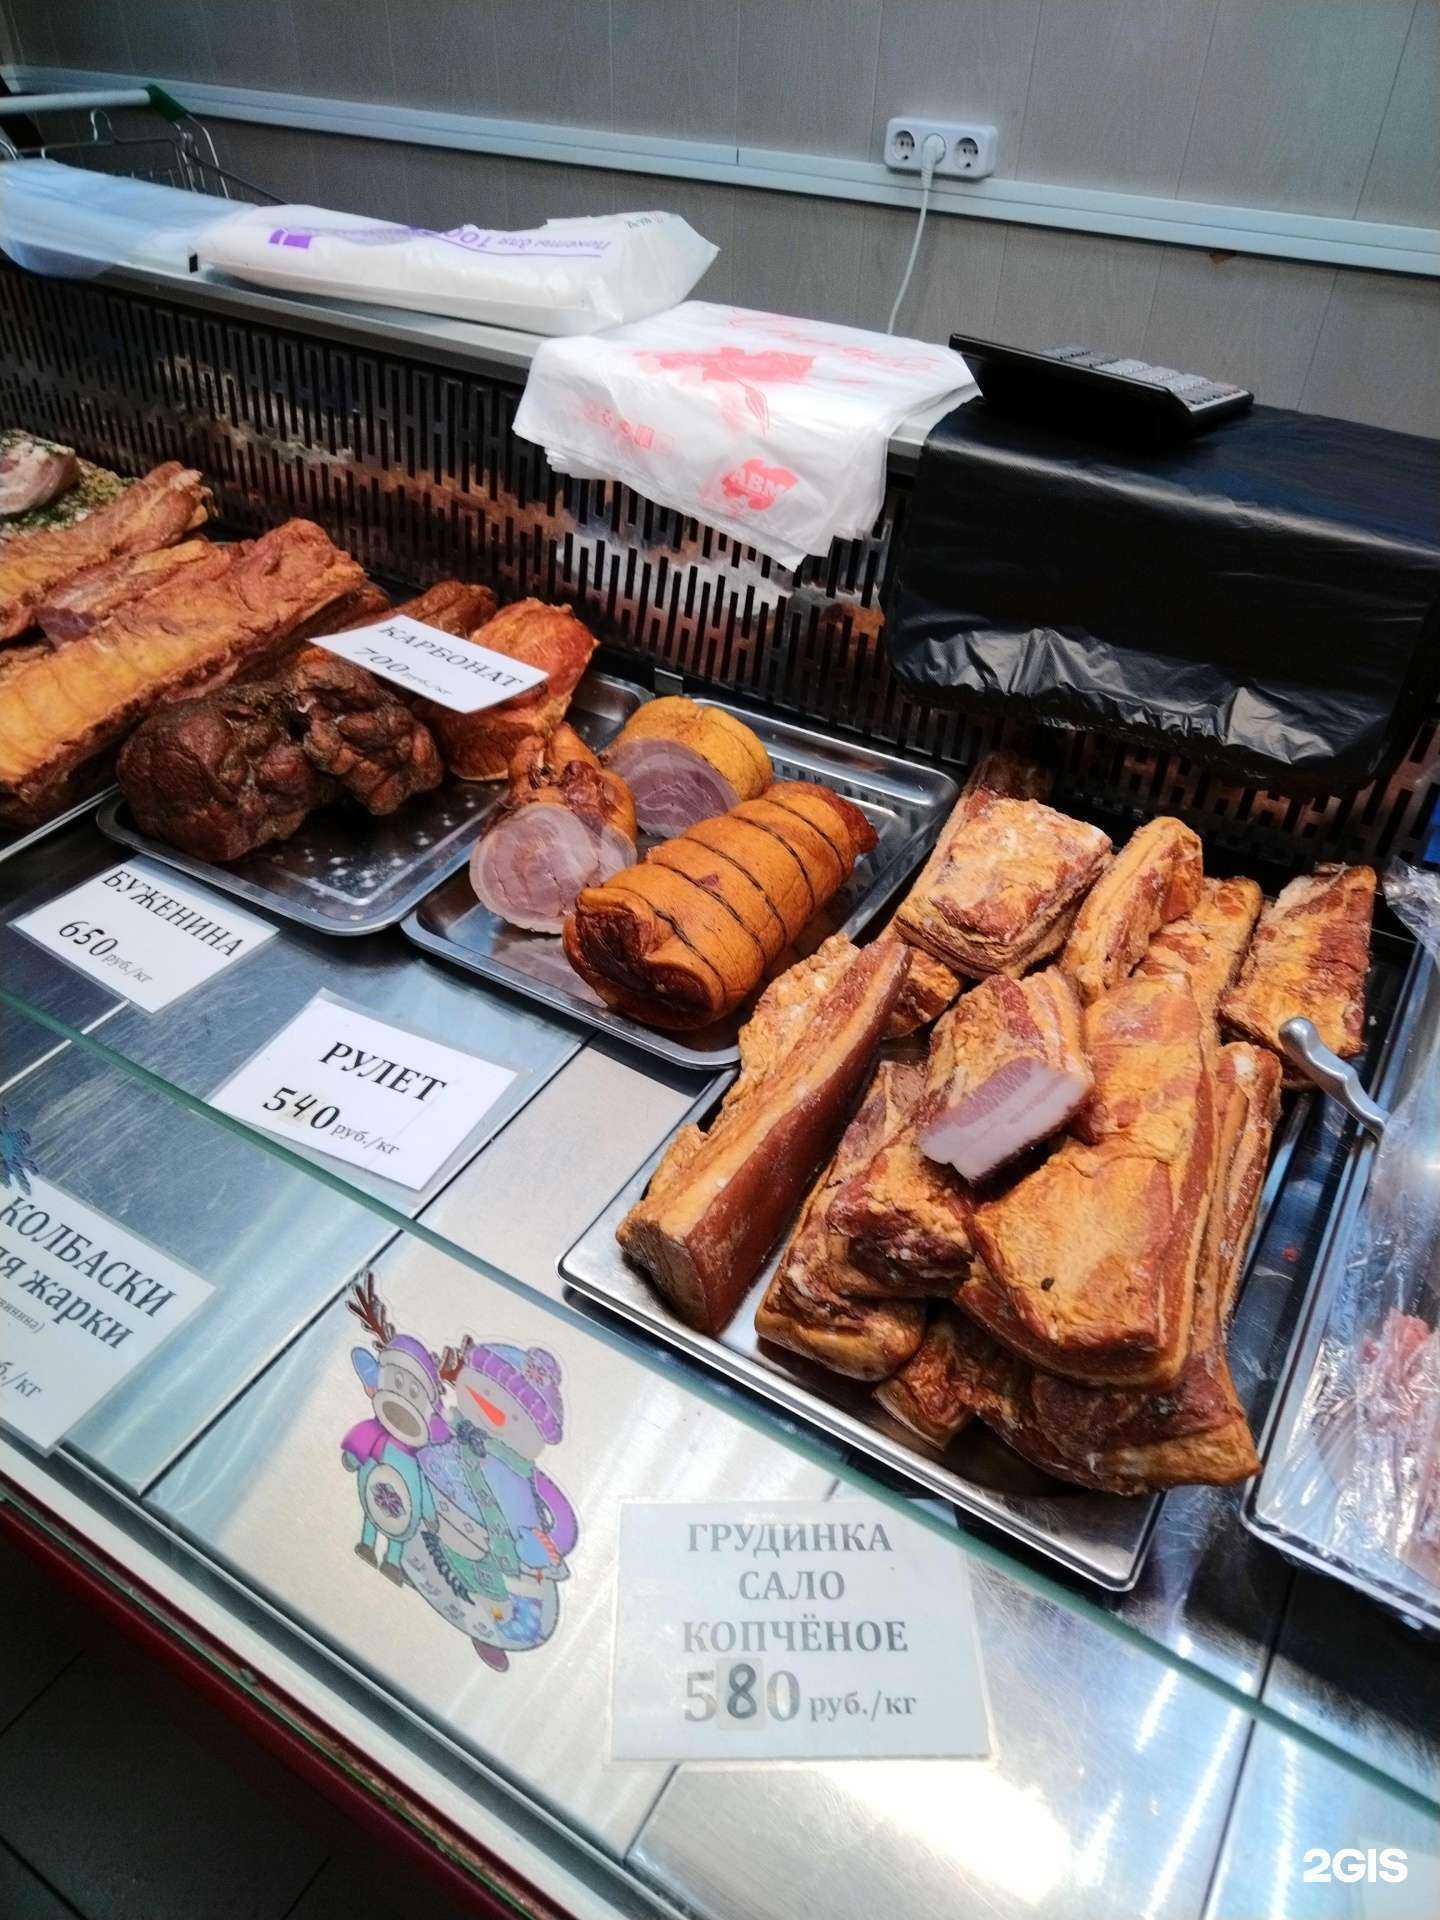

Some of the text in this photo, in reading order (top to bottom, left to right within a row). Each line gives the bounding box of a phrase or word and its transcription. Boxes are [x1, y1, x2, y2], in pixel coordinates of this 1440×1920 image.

[354, 646, 410, 672] 700
[379, 625, 524, 687] КАРБОНАТ
[59, 920, 118, 957] 650
[102, 870, 244, 957] БУЖЕНИНА
[318, 1041, 447, 1101] РУЛЕТ
[262, 1087, 400, 1155] 540 руб./кг
[0, 1196, 176, 1318] КОЛБАСКИ
[19, 1269, 134, 1349] жарки
[688, 1523, 893, 1557] ГРУДИНКА
[739, 1571, 845, 1600] САЛО
[682, 1613, 909, 1652] КОПЧЁНОЕ
[684, 1663, 917, 1722] 580 руб./кг
